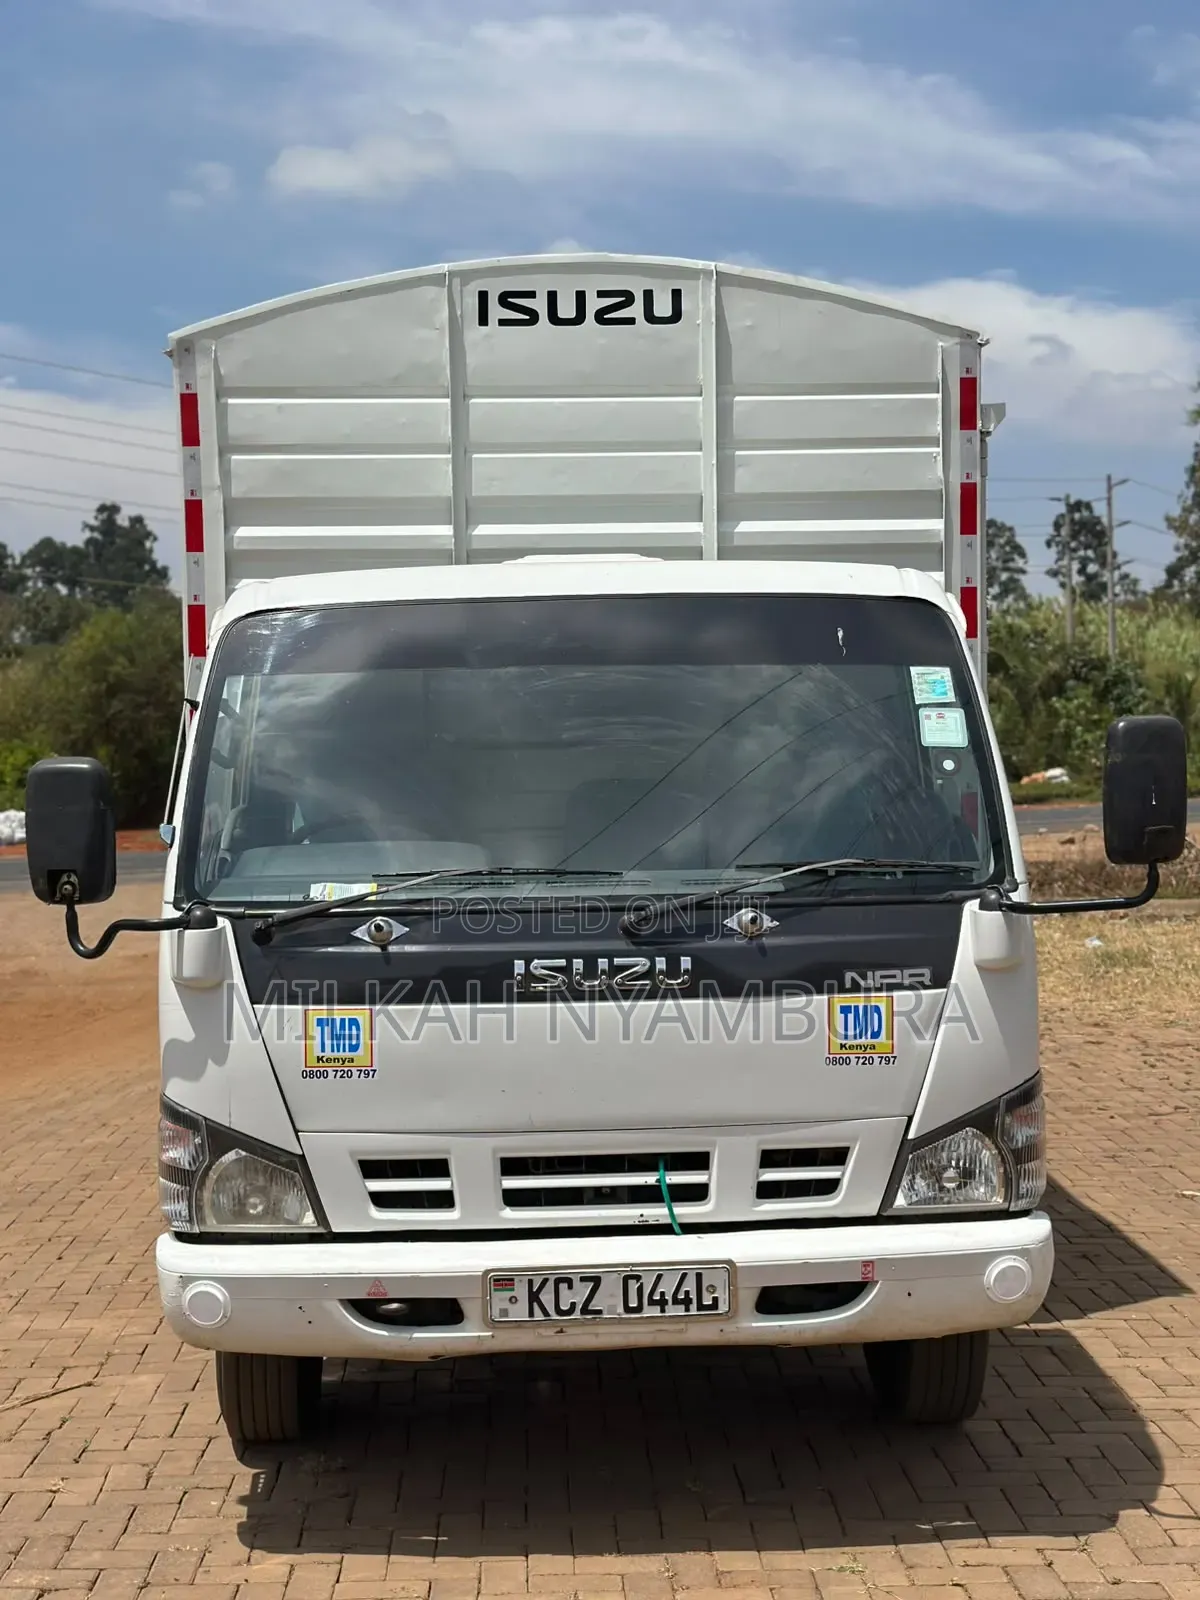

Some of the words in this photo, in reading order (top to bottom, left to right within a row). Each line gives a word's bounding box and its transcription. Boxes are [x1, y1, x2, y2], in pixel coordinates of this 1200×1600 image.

[477, 288, 682, 327] ISUZU
[513, 956, 692, 993] ISUZU
[846, 969, 932, 988] NPR
[316, 1017, 361, 1053] TMD
[839, 1004, 883, 1040] TMD
[316, 1055, 355, 1065] Kenya
[825, 1056, 851, 1066] 0800
[854, 1055, 875, 1066] 720
[877, 1055, 898, 1066] 797
[839, 1042, 876, 1052] Kenya
[301, 1069, 329, 1079] 0800
[332, 1069, 353, 1079] 720
[356, 1069, 377, 1079] 797
[527, 1276, 603, 1318] KCZ
[622, 1271, 719, 1315] 044L
